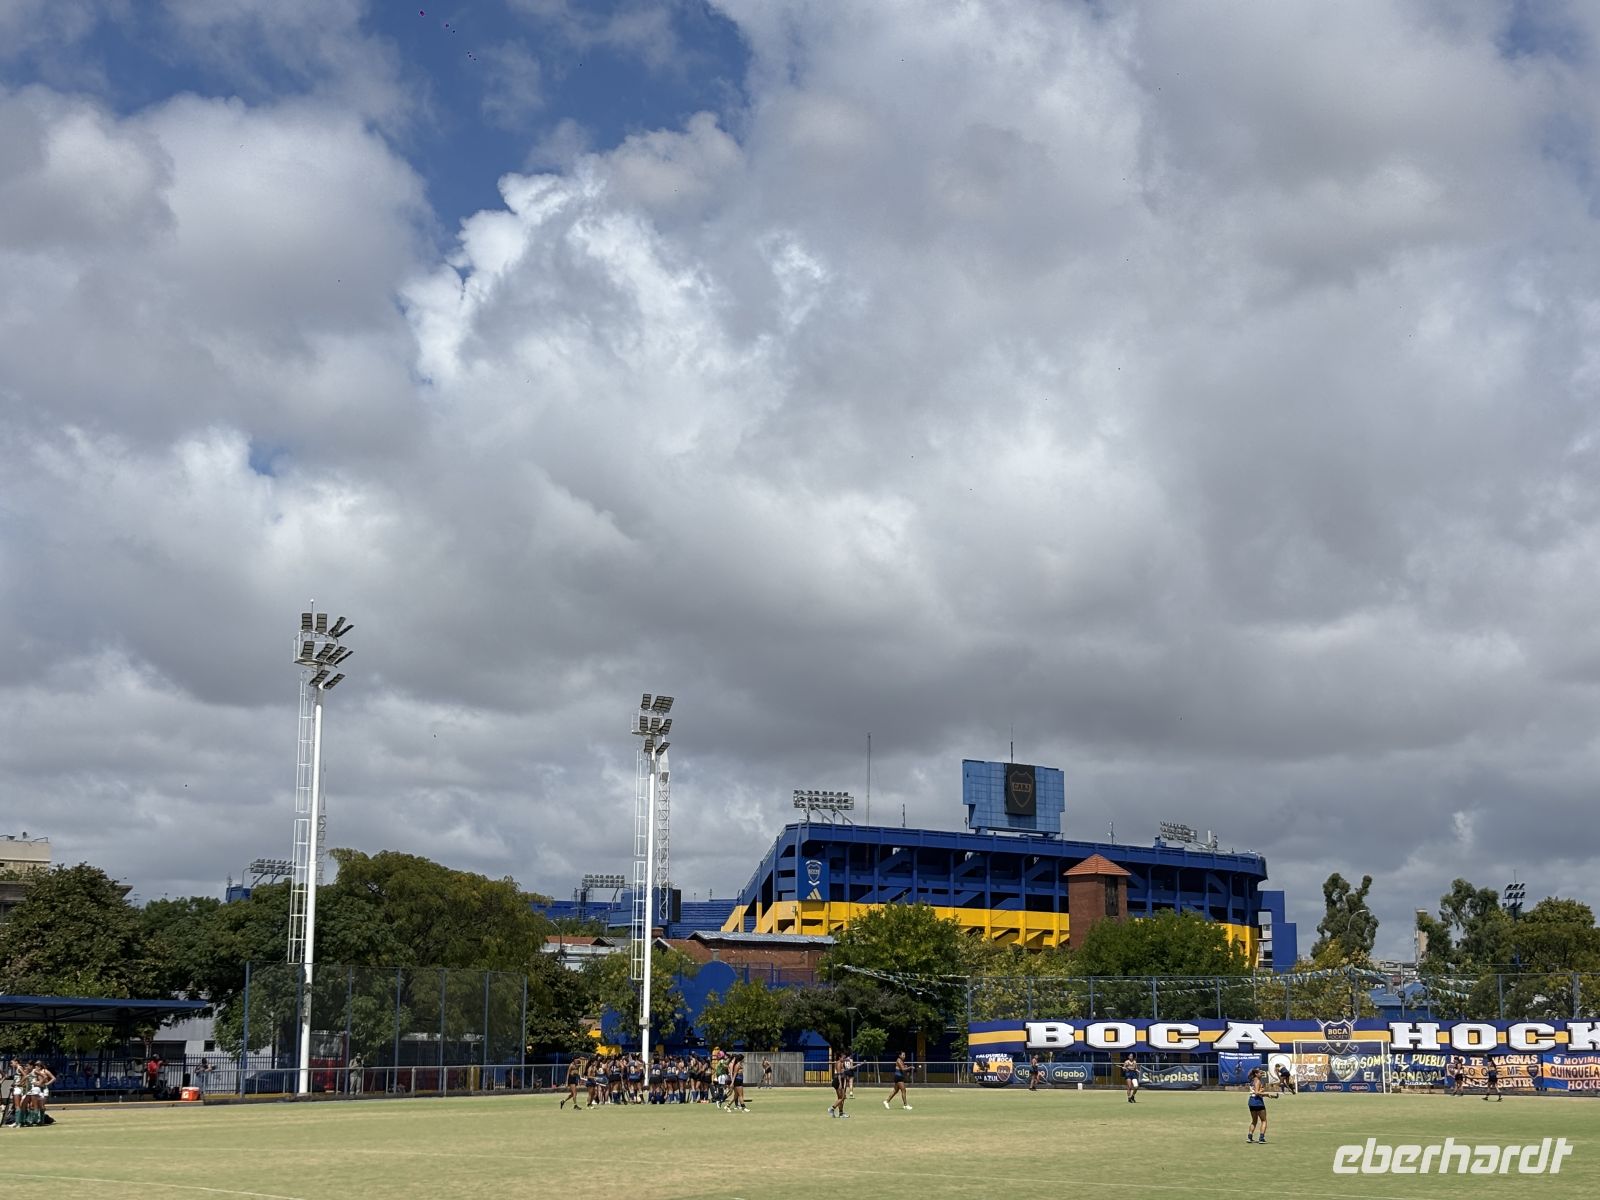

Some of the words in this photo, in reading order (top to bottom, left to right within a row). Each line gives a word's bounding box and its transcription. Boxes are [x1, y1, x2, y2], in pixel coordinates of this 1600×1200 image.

[1025, 1022, 1280, 1049] BOCA
[1394, 1053, 1407, 1065] EL
[1411, 1053, 1446, 1068] PUEBLO
[1470, 1057, 1484, 1066] TE
[1055, 1069, 1085, 1080] algabo
[1142, 1071, 1199, 1083] Sinteplast
[1364, 1071, 1377, 1082] EL
[1481, 1067, 1502, 1077] QE
[1507, 1066, 1522, 1076] ME
[1550, 1065, 1600, 1079] QUINQUELA
[1497, 1077, 1535, 1088] SENTIR
